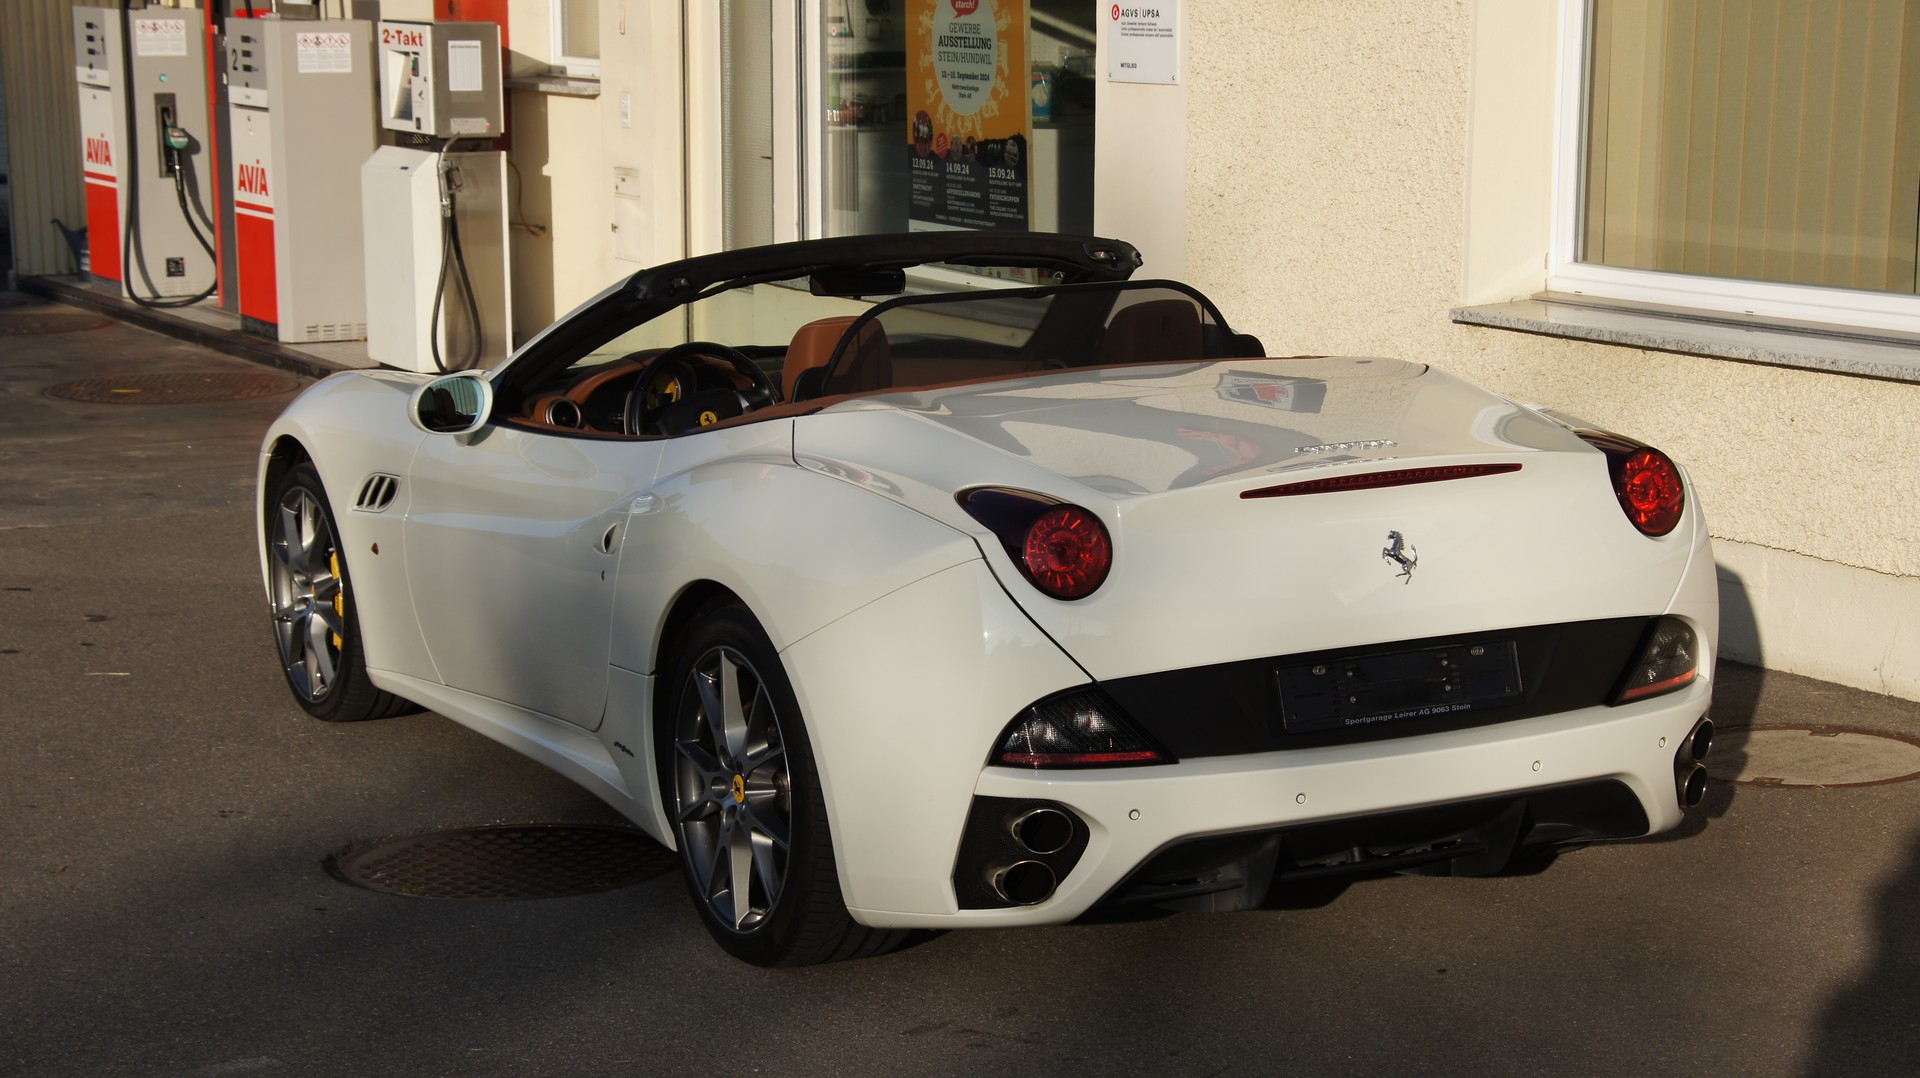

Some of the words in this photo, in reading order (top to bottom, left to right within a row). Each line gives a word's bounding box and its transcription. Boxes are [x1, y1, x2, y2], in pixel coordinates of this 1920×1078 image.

[955, 0, 975, 9] starch!
[1121, 8, 1138, 18] AGVS
[1142, 9, 1160, 18] UPSA
[949, 22, 981, 35] GEWERBE
[382, 28, 424, 47] 2-Takt
[938, 35, 992, 50] AUSSTELLUNG
[231, 48, 239, 71] 2
[937, 50, 992, 65] STEIN/HUNDWIL
[957, 71, 980, 82] September
[980, 73, 990, 82] 2024
[912, 158, 934, 170] 13.09.24
[946, 162, 970, 175] 14.09.24
[989, 167, 1015, 180] 15.09.24
[1344, 713, 1393, 726] Sportgarage
[1394, 710, 1417, 719] Leirer
[1419, 708, 1430, 716] AG
[1431, 706, 1450, 714] 9063
[1451, 703, 1471, 712] Stein
